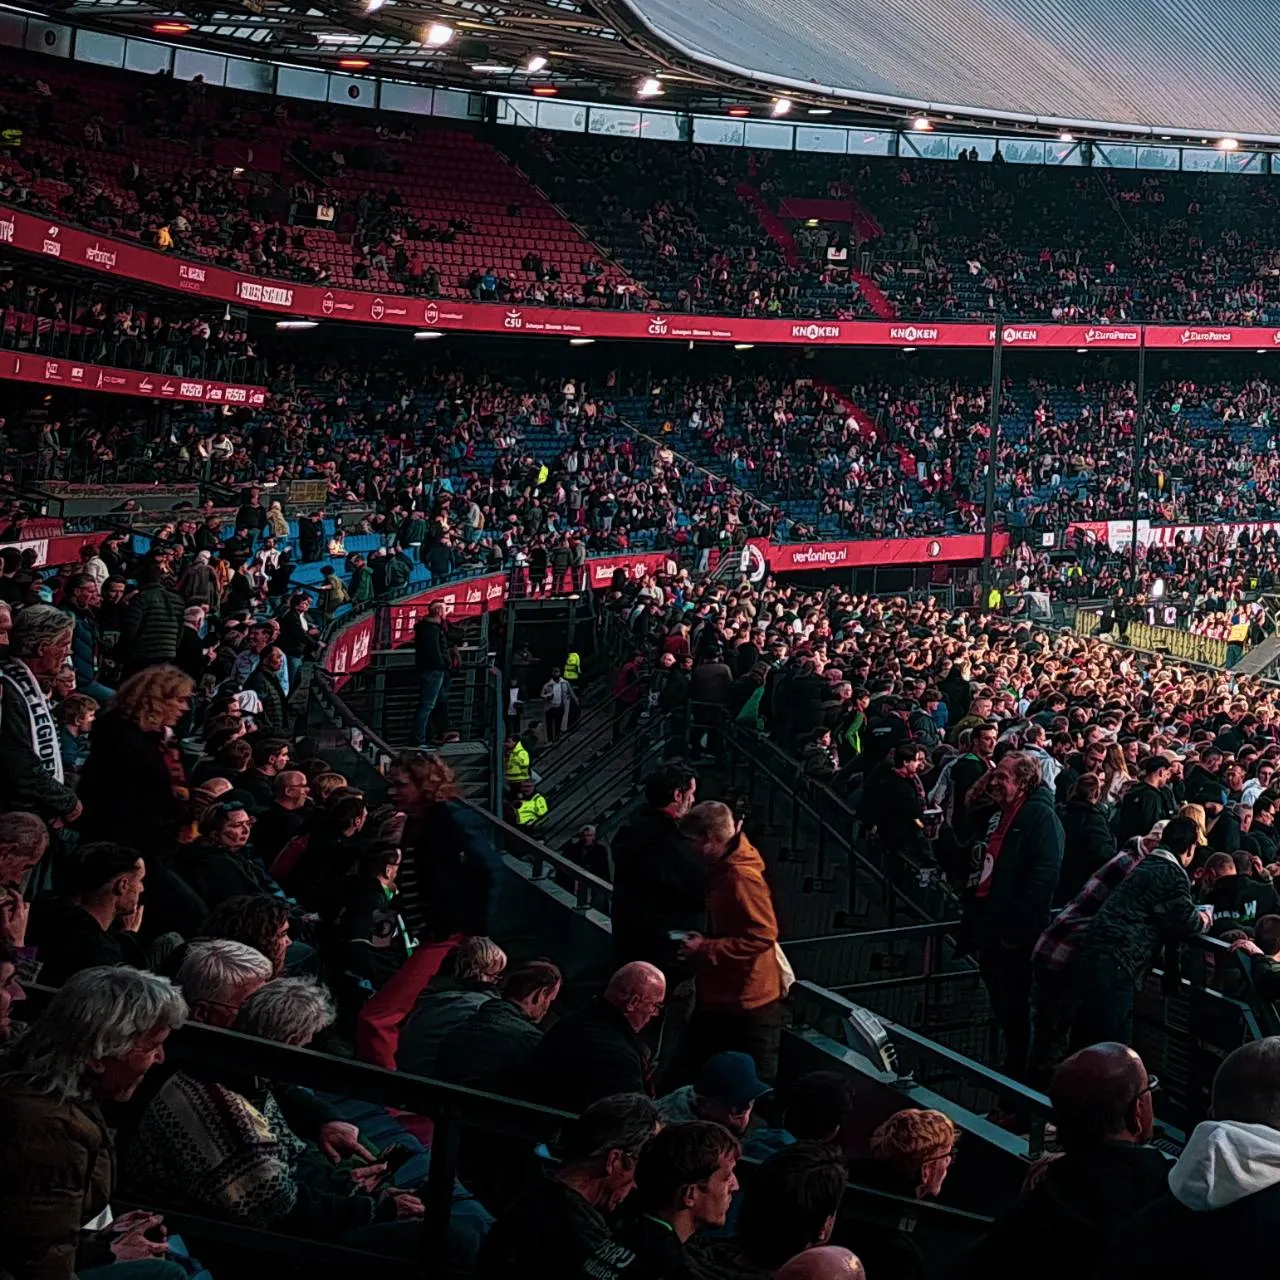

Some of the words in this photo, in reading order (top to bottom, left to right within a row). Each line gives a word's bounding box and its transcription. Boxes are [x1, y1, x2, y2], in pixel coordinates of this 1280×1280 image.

[505, 318, 522, 328] CSU
[648, 324, 668, 335] CSU
[792, 325, 839, 339] KNAKEN
[890, 326, 937, 341] KNAKEN
[793, 548, 847, 563] verloning.nl
